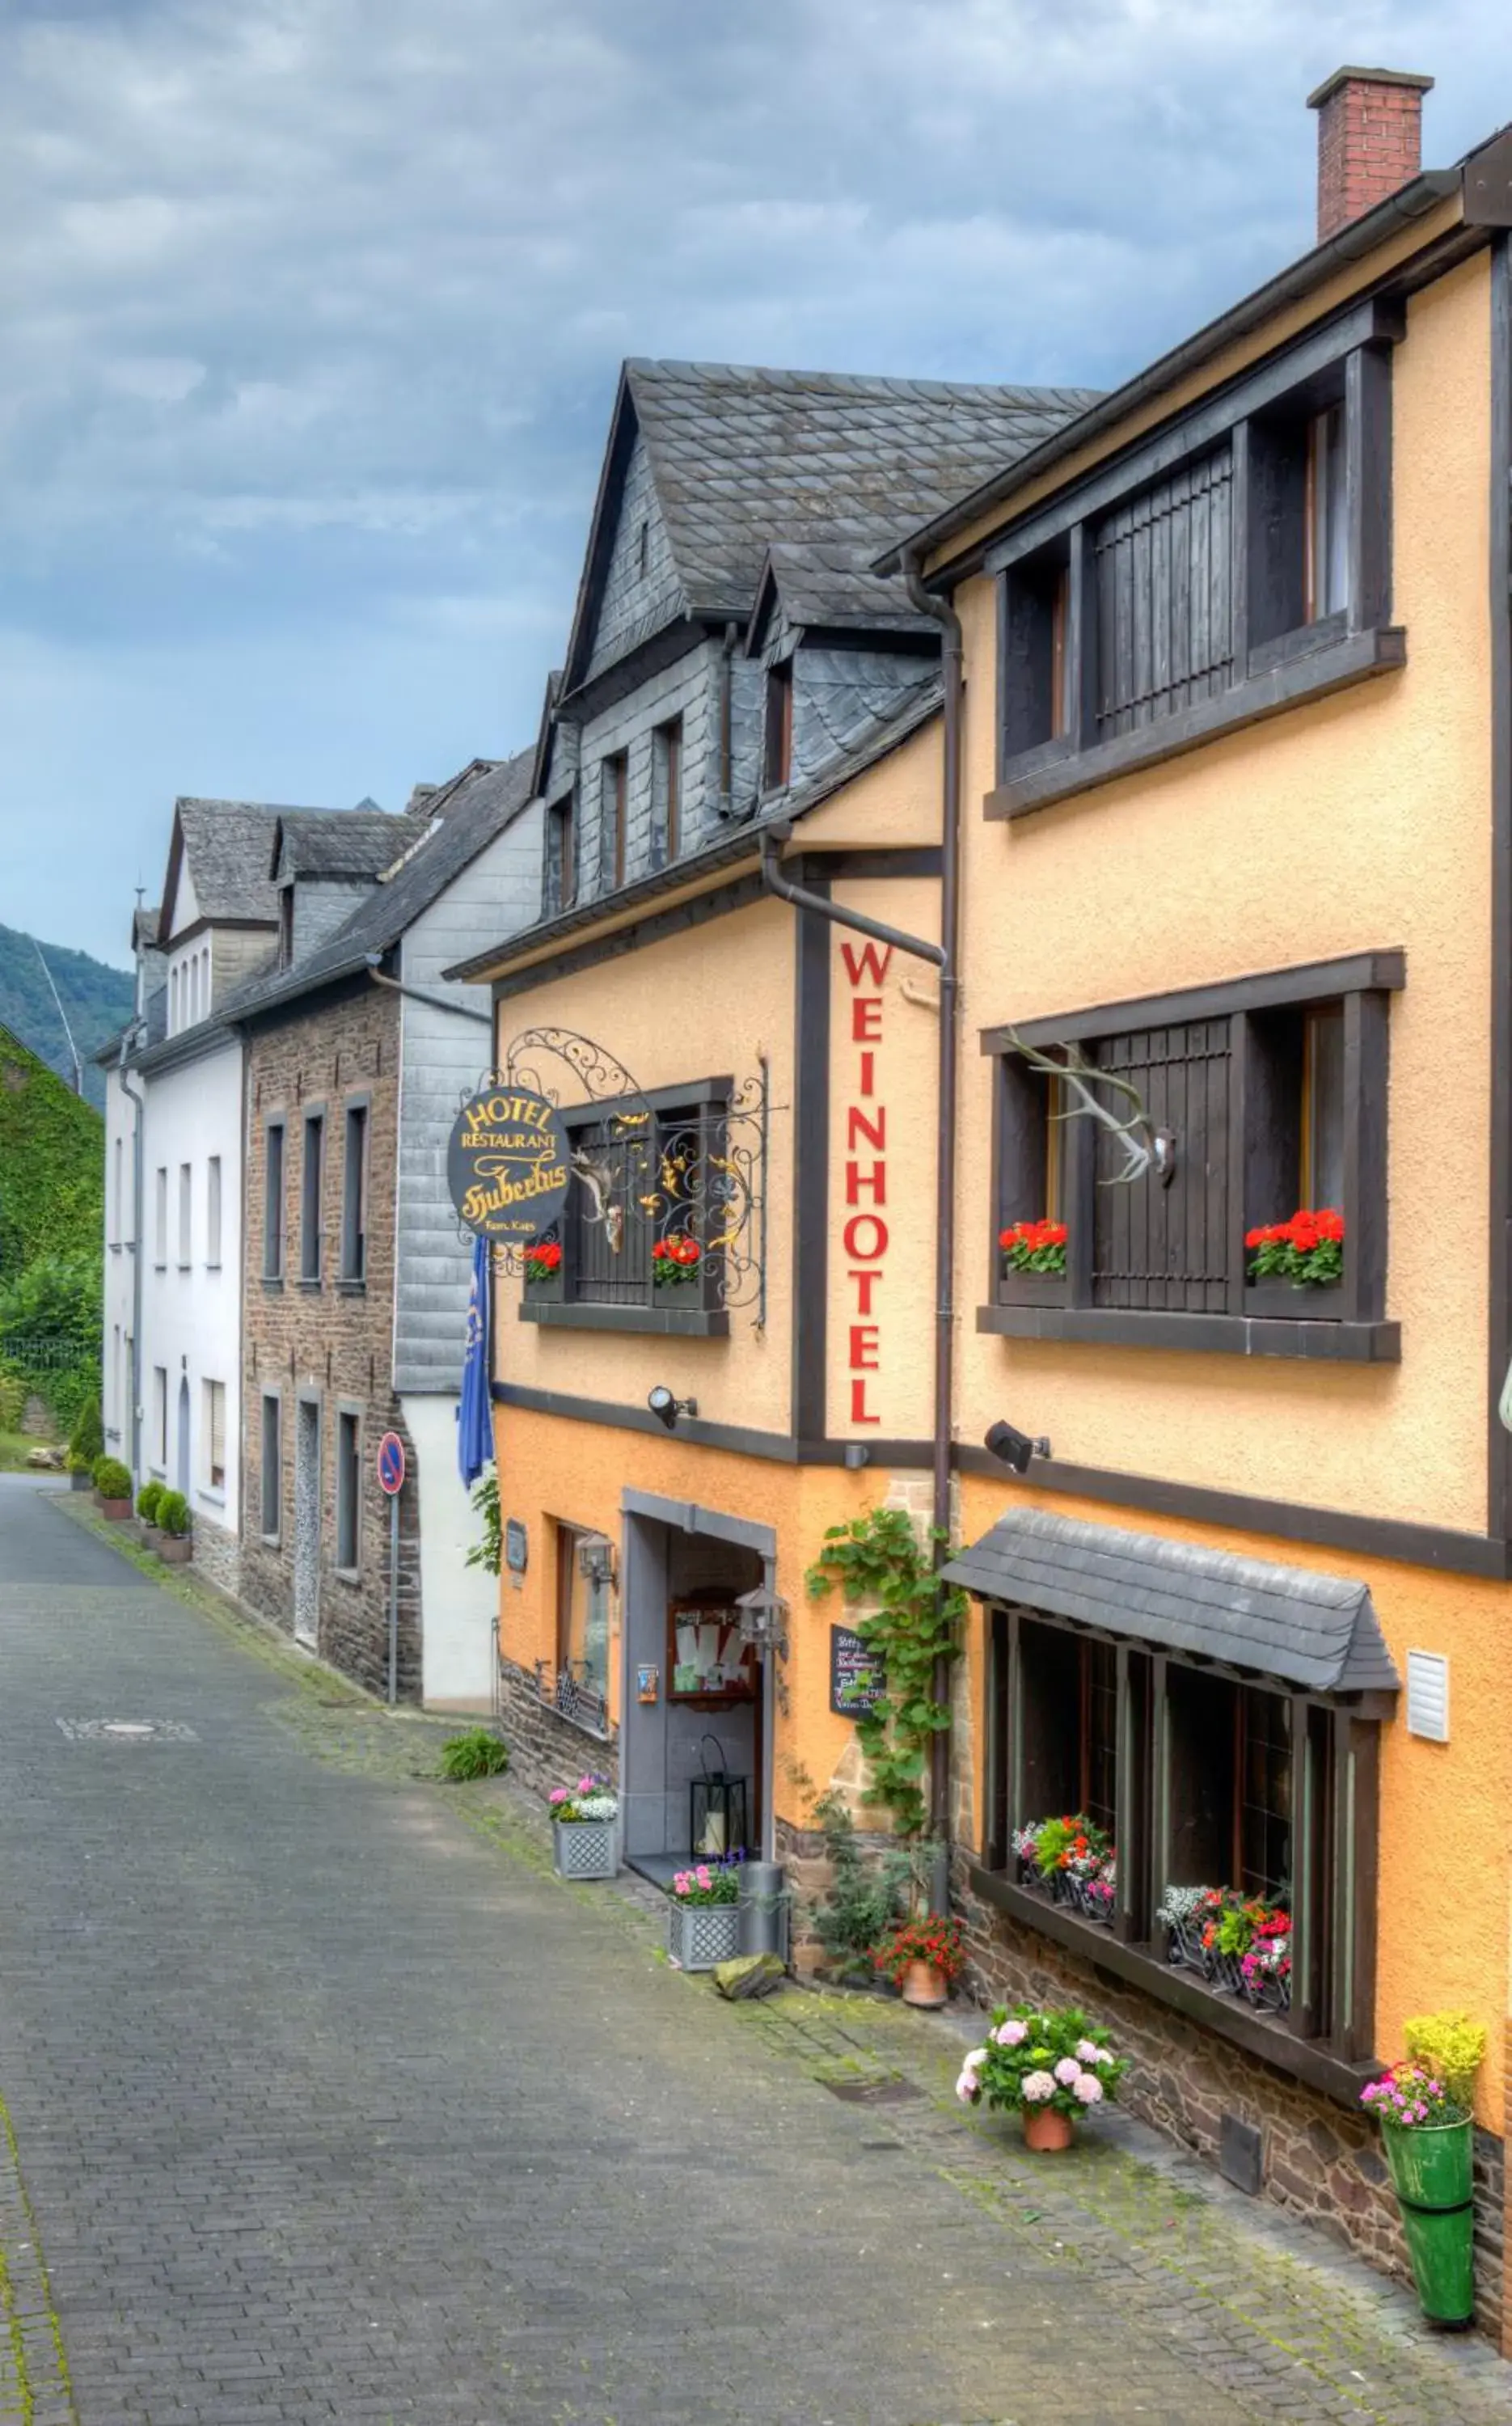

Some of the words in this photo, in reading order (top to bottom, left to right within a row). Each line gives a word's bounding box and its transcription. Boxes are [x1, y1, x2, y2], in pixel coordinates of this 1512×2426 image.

[462, 1133, 556, 1147] RESTAURANT
[466, 1097, 551, 1132] HOTEL
[462, 1150, 566, 1224] Hubertus
[840, 942, 893, 1426] WEINHOTEL
